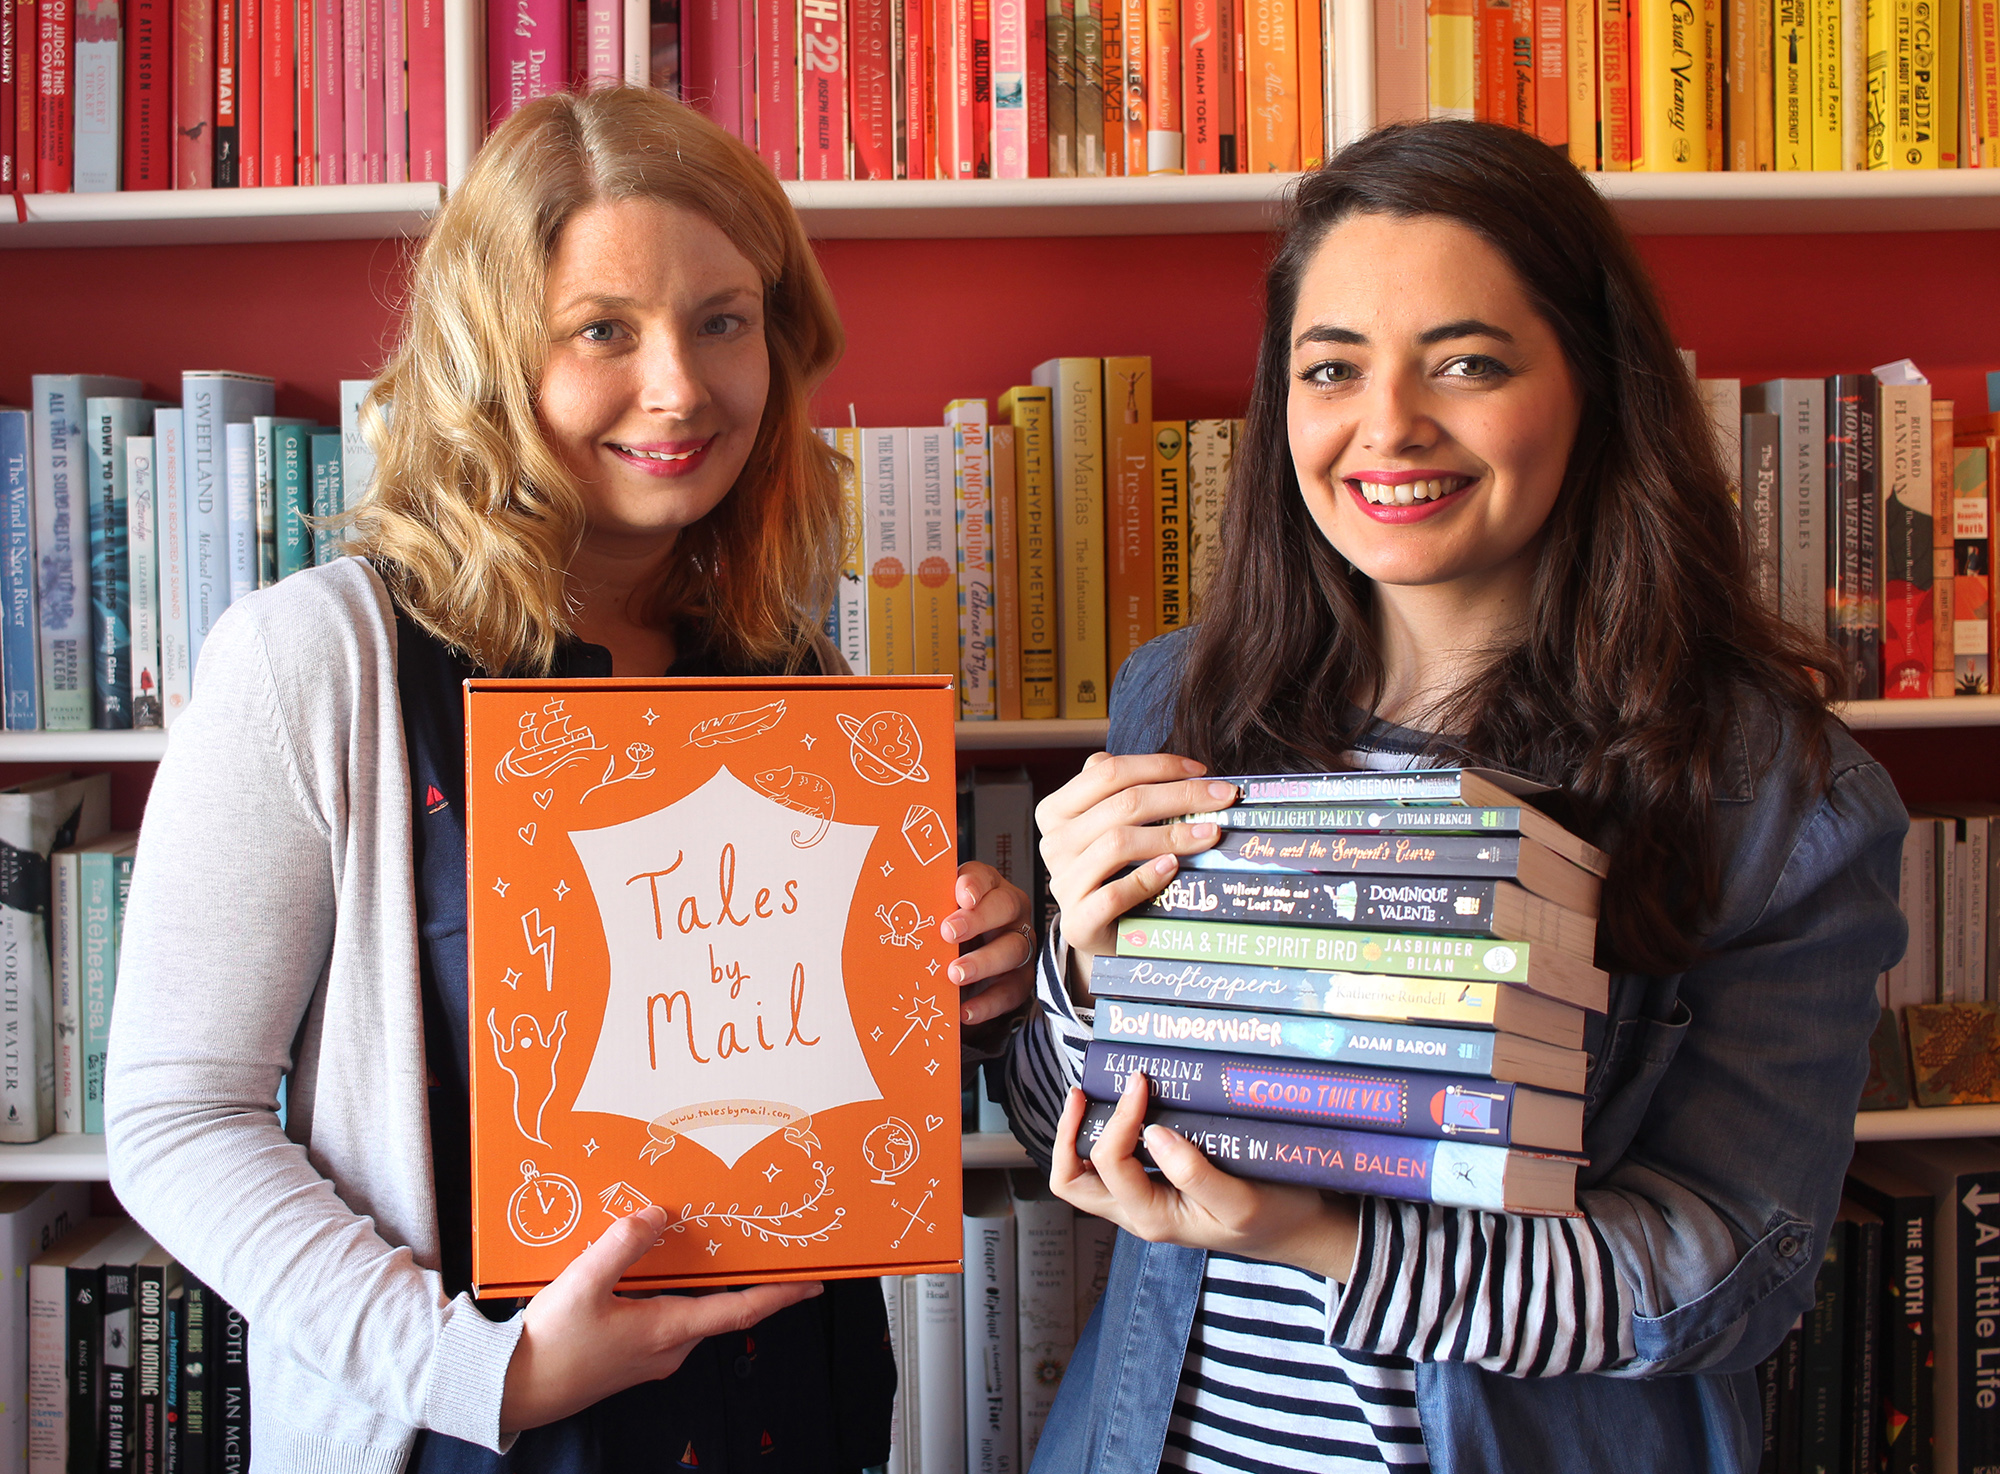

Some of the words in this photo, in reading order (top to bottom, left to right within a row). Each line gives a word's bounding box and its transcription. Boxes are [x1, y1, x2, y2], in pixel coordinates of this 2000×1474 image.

[42, 3, 53, 19] BY
[1670, 0, 1695, 58] Casual
[1898, 17, 1910, 34] IT'S
[1982, 2, 1995, 38] DEATH
[42, 22, 53, 40] ITS
[53, 24, 66, 67] JUDGE
[910, 34, 918, 50] The
[1000, 2, 1018, 66] ORTH
[1104, 12, 1122, 59] THE
[1898, 37, 1910, 53] ALL
[42, 42, 53, 96] COVER?
[139, 18, 152, 90] ATKINSON
[910, 51, 918, 86] Summer
[1128, 0, 1142, 122] SHIPWRECKS
[1602, 20, 1622, 83] SISTERS
[1984, 40, 1996, 64] AND
[53, 70, 66, 95] THIS
[974, 39, 989, 103] ABLUTIONS
[1195, 47, 1206, 96] MIRIAM
[1788, 66, 1800, 94] JOHN
[1898, 56, 1910, 86] ABOUT
[1985, 66, 1997, 88] THE
[219, 67, 233, 115] MAN
[818, 77, 829, 112] JOSEPH
[910, 87, 919, 122] Without
[1104, 65, 1122, 123] MAZE
[1667, 59, 1694, 133] Vacancy
[1898, 89, 1910, 106] THE
[818, 115, 829, 150] HELLER
[911, 122, 919, 140] Men
[1196, 99, 1207, 144] TOEWS
[1609, 87, 1629, 163] BROTHERS
[1788, 97, 1800, 146] BERENDT
[1898, 107, 1910, 127] BIKE
[1986, 89, 1999, 138] PENGUIN
[140, 98, 150, 180] TRANSCRIPTION
[425, 149, 433, 180] VINTAGE
[820, 155, 828, 180] VINTAGE
[1073, 381, 1093, 446] Javier
[1798, 398, 1810, 434] THE
[196, 391, 214, 515] SWEETLAND
[257, 436, 268, 469] NAT
[962, 422, 981, 446] MR
[1894, 399, 1908, 495] FLANAGAN
[1910, 416, 1921, 478] RICHARD
[8, 453, 24, 486] The
[285, 437, 298, 481] GREG
[1761, 444, 1773, 468] The
[258, 471, 269, 509] TATE
[963, 455, 986, 509] LYNCH'S
[1025, 417, 1043, 560] MULTI-HYPHEN
[1074, 452, 1095, 526] Marías
[1161, 468, 1178, 525] LITTLE
[1798, 443, 1811, 550] MANDIBLES
[10, 488, 26, 529] Wind
[286, 486, 299, 547] BAXTER
[1126, 455, 1146, 557] Presence
[1754, 469, 1775, 550] Forgiven
[12, 532, 26, 545] Is
[198, 530, 211, 579] Michael
[965, 514, 986, 572] HOLIDAY
[1075, 538, 1088, 563] The
[1162, 528, 1179, 585] GREEN
[13, 577, 22, 586] a
[14, 588, 28, 628] River
[197, 582, 213, 637] Crummey
[969, 580, 989, 637] Catherine
[1028, 566, 1046, 645] METHOD
[1076, 567, 1089, 642] Infatuations
[1163, 589, 1181, 626] MEN
[847, 599, 860, 662] TRILLIN
[53, 639, 66, 691] MCKEON
[66, 639, 78, 691] DARRAGH
[965, 641, 987, 690] O'Flynn
[1250, 781, 1311, 799] RUINED
[1344, 778, 1416, 797] SLEEPOVER
[1249, 810, 1317, 828] TWILIGHT
[1318, 810, 1365, 827] PARTY
[1396, 812, 1432, 826] VIVIAN
[1433, 812, 1473, 826] FRENCH
[1239, 835, 1276, 859] Orla
[1279, 839, 1304, 858] and
[1308, 838, 1328, 859] the
[1331, 837, 1390, 869] Serpent's
[1395, 838, 1437, 864] Curse
[92, 879, 104, 904] The
[625, 843, 798, 940] Tales
[1153, 879, 1219, 913] RFELL
[1222, 882, 1260, 897] Willow
[1263, 885, 1291, 898] Moss
[1292, 888, 1310, 899] and
[1232, 897, 1247, 907] the
[1247, 897, 1272, 911] Lost
[1274, 901, 1296, 915] Day
[1369, 884, 1449, 904] DOMINIQUE
[1378, 904, 1437, 922] VALENTE
[1149, 928, 1195, 951] ASHA
[1199, 931, 1212, 953] &
[1216, 932, 1249, 956] THE
[1254, 935, 1312, 960] SPIRIT
[1315, 938, 1358, 962] BIRD
[1383, 938, 1474, 957] JASBINDER
[3, 940, 18, 1013] NORTH
[87, 906, 109, 1043] Rehearsal
[708, 944, 751, 999] by
[1129, 961, 1288, 1002] Rooftoppers
[1406, 956, 1455, 973] BILAN
[1335, 985, 1396, 1003] Katherine
[1397, 989, 1447, 1006] Rundell
[647, 962, 821, 1070] Mail
[5, 1020, 19, 1092] WATER
[1347, 1035, 1394, 1052] ADAM
[1395, 1039, 1448, 1057] BARON
[1103, 1052, 1204, 1082] KATHERINE
[1113, 1073, 1191, 1102] RDELL
[1235, 1079, 1246, 1097] THE
[1248, 1079, 1312, 1104] GOOD
[1317, 1084, 1395, 1113] THIEVES
[670, 1106, 791, 1126] www.talesbymail.com
[1089, 1118, 1105, 1142] THE
[1184, 1129, 1241, 1160] WE'RE
[1275, 1142, 1345, 1171] KATYA
[1353, 1152, 1427, 1180] BALEN
[890, 1239, 901, 1249] S
[926, 1222, 937, 1234] E
[1906, 1217, 1922, 1249] THE
[1975, 1222, 1999, 1247] A
[925, 1290, 950, 1299] Head
[1905, 1255, 1923, 1315] MOTH
[1975, 1255, 2000, 1339] Little
[78, 1339, 87, 1367] KING
[78, 1370, 87, 1396] LEAR
[109, 1372, 124, 1399] NED
[1975, 1348, 2000, 1409] Life
[109, 1404, 124, 1470] BEAUMAN
